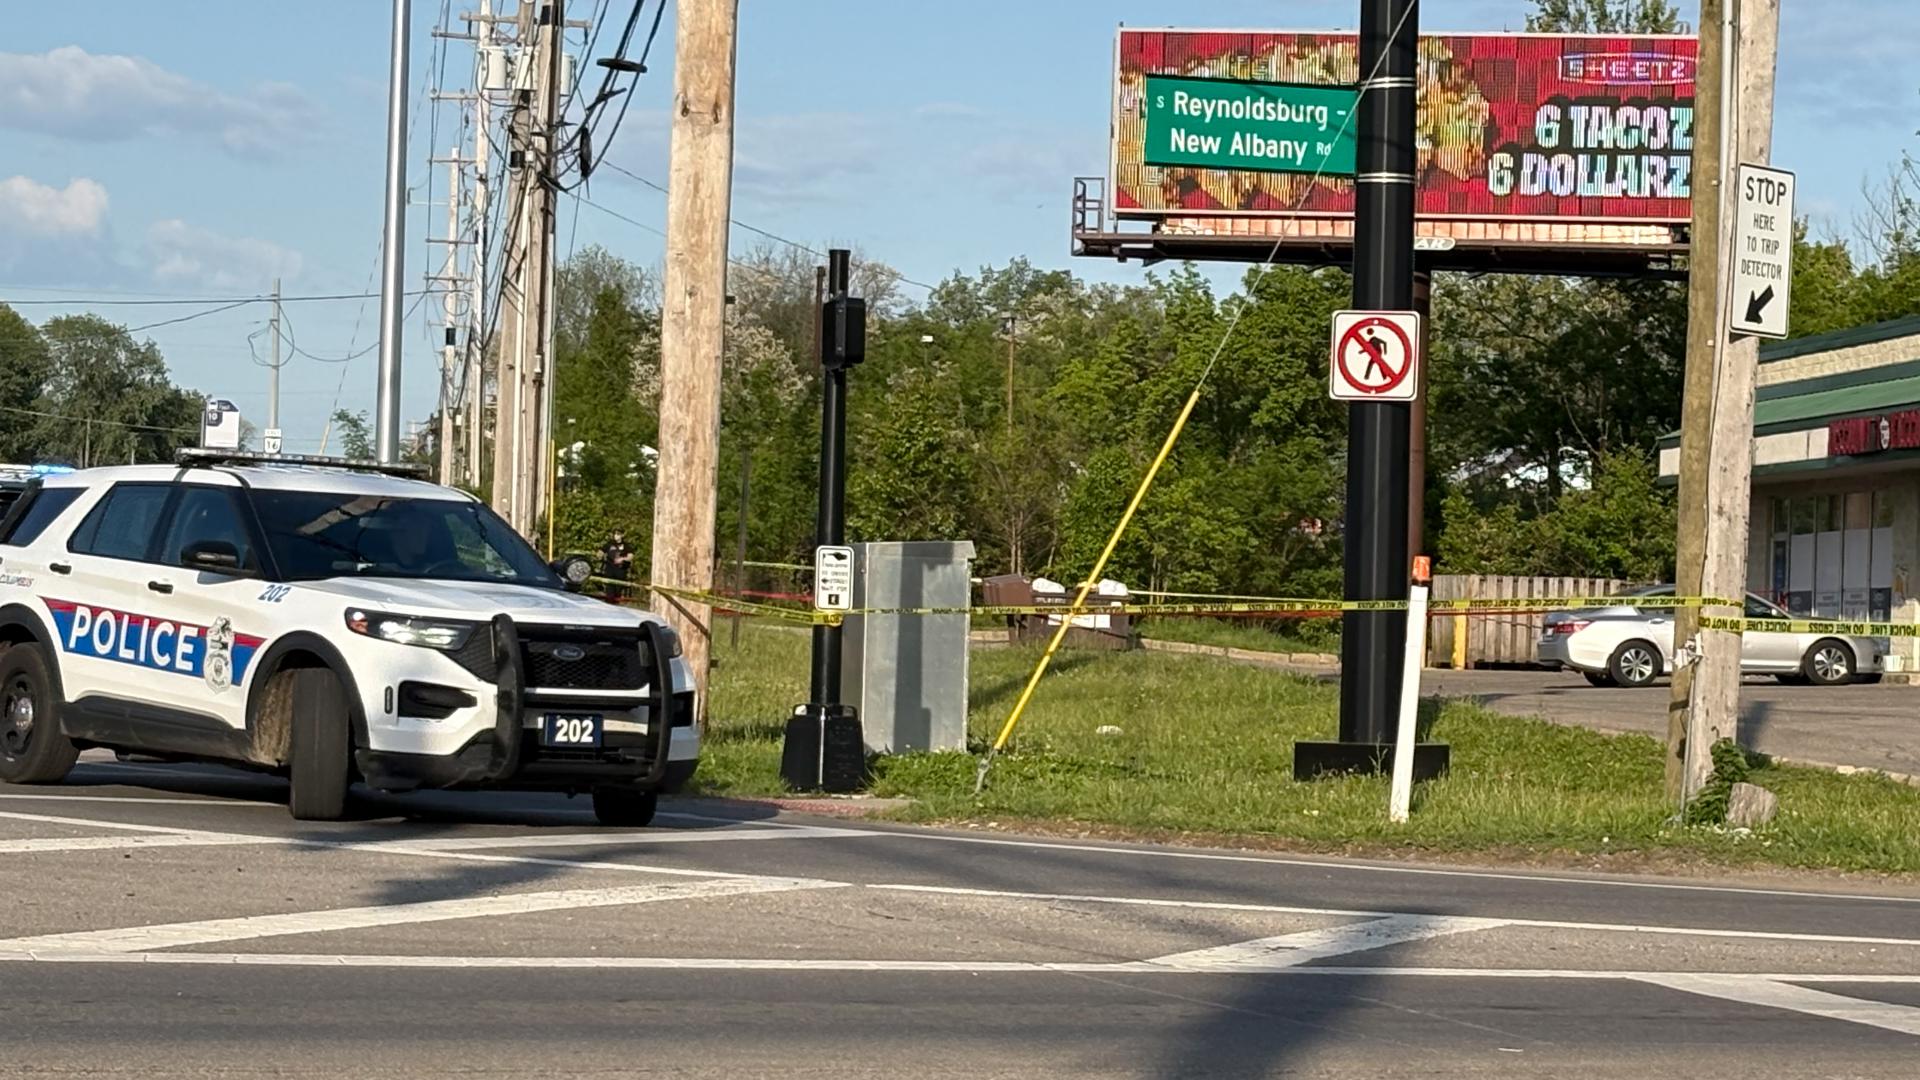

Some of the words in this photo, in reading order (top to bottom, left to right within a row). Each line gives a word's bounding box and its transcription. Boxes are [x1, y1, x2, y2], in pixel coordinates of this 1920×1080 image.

[1156, 95, 1165, 108] S
[1174, 91, 1328, 132] Reynoldsburg
[1535, 104, 1562, 149] 6
[1568, 105, 1693, 150] TACOZ
[1170, 128, 1222, 154] New
[1230, 131, 1308, 166] Albany
[1316, 142, 1332, 157] Rd
[1488, 153, 1514, 196] 6
[1520, 153, 1691, 198] DOLLARZ
[1746, 176, 1787, 206] STOP
[1753, 213, 1775, 232] HERE
[1747, 235, 1757, 252] TO
[1761, 238, 1780, 255] TRIP
[1741, 258, 1782, 280] DETECTOR
[257, 584, 291, 603] 202
[1712, 618, 1728, 629] NOT
[1729, 619, 1741, 630] DO
[1747, 620, 1763, 632] LINE
[1764, 621, 1792, 633] POLICE
[1808, 623, 1834, 634] CROSS
[1836, 623, 1851, 634] NOT
[1853, 624, 1864, 635] DO
[1871, 624, 1887, 635] LINE
[1890, 624, 1917, 636] POLICE
[68, 605, 199, 671] POLICE
[555, 719, 594, 743] 202
